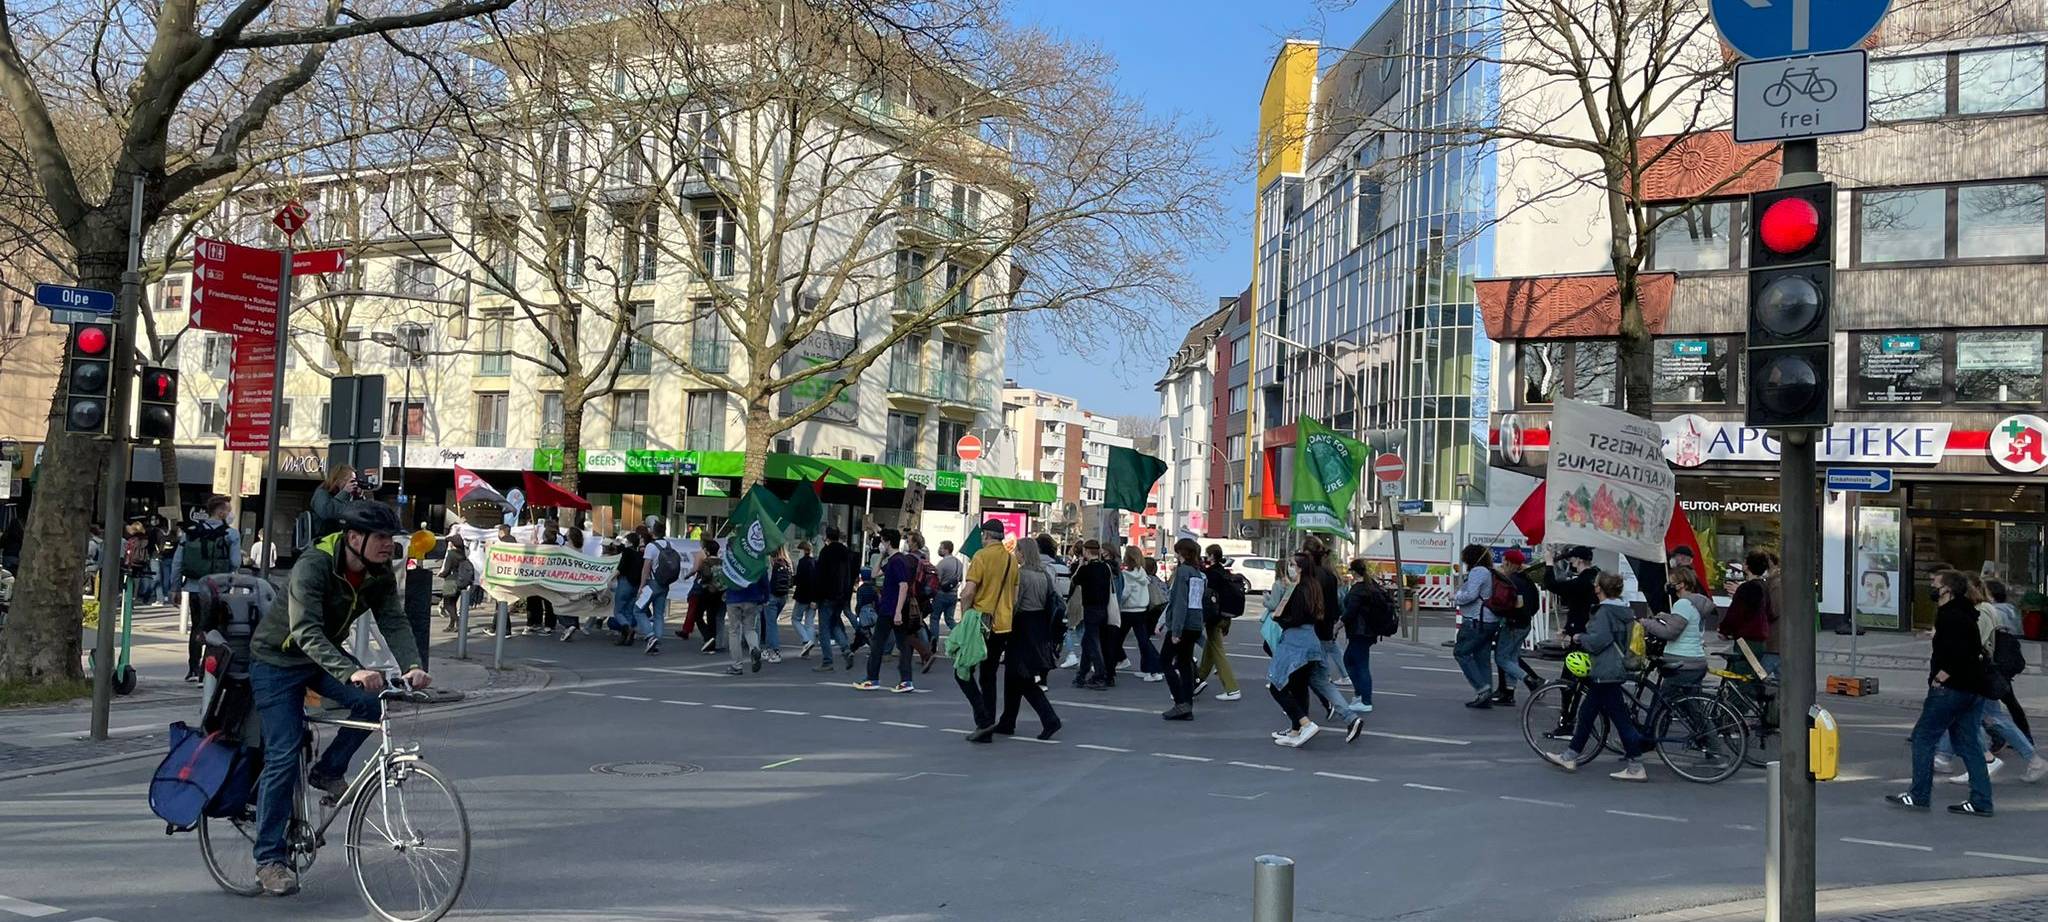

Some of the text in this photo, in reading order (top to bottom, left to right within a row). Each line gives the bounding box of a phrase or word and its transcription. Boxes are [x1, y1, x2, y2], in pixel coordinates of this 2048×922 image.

[1780, 109, 1820, 128] frei
[256, 281, 279, 292] Change
[62, 289, 89, 306] Olpe
[244, 303, 277, 314] Hansaplatz
[232, 323, 275, 335] Theater Oper
[257, 319, 275, 328] Markt
[1707, 426, 1933, 457] APOHEKE
[1333, 439, 1349, 458] FOR
[588, 455, 617, 466] GEERS
[938, 475, 960, 488] GUTES
[557, 557, 574, 568] DAS
[496, 565, 512, 576] DIE
[513, 566, 547, 578] URSACHE
